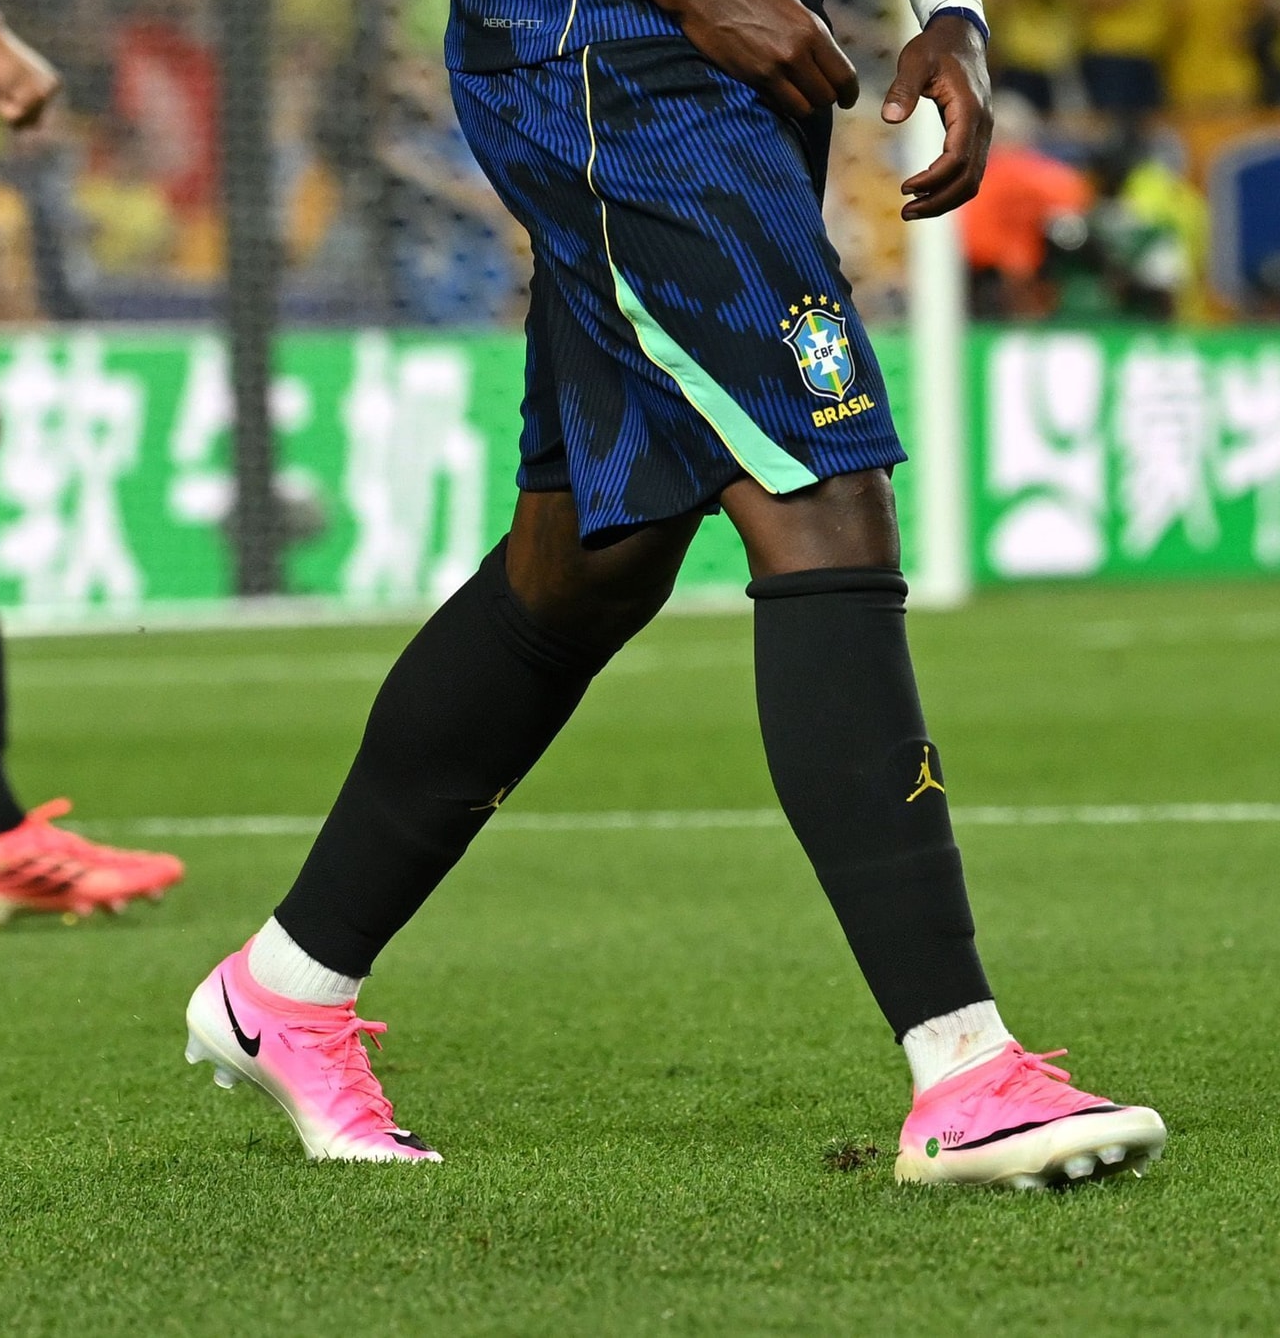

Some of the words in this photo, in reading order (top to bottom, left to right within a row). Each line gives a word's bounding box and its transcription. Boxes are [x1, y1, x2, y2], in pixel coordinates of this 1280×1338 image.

[482, 17, 544, 30] AERO-FIT
[813, 344, 835, 361] CBF
[811, 393, 875, 428] BRASIL
